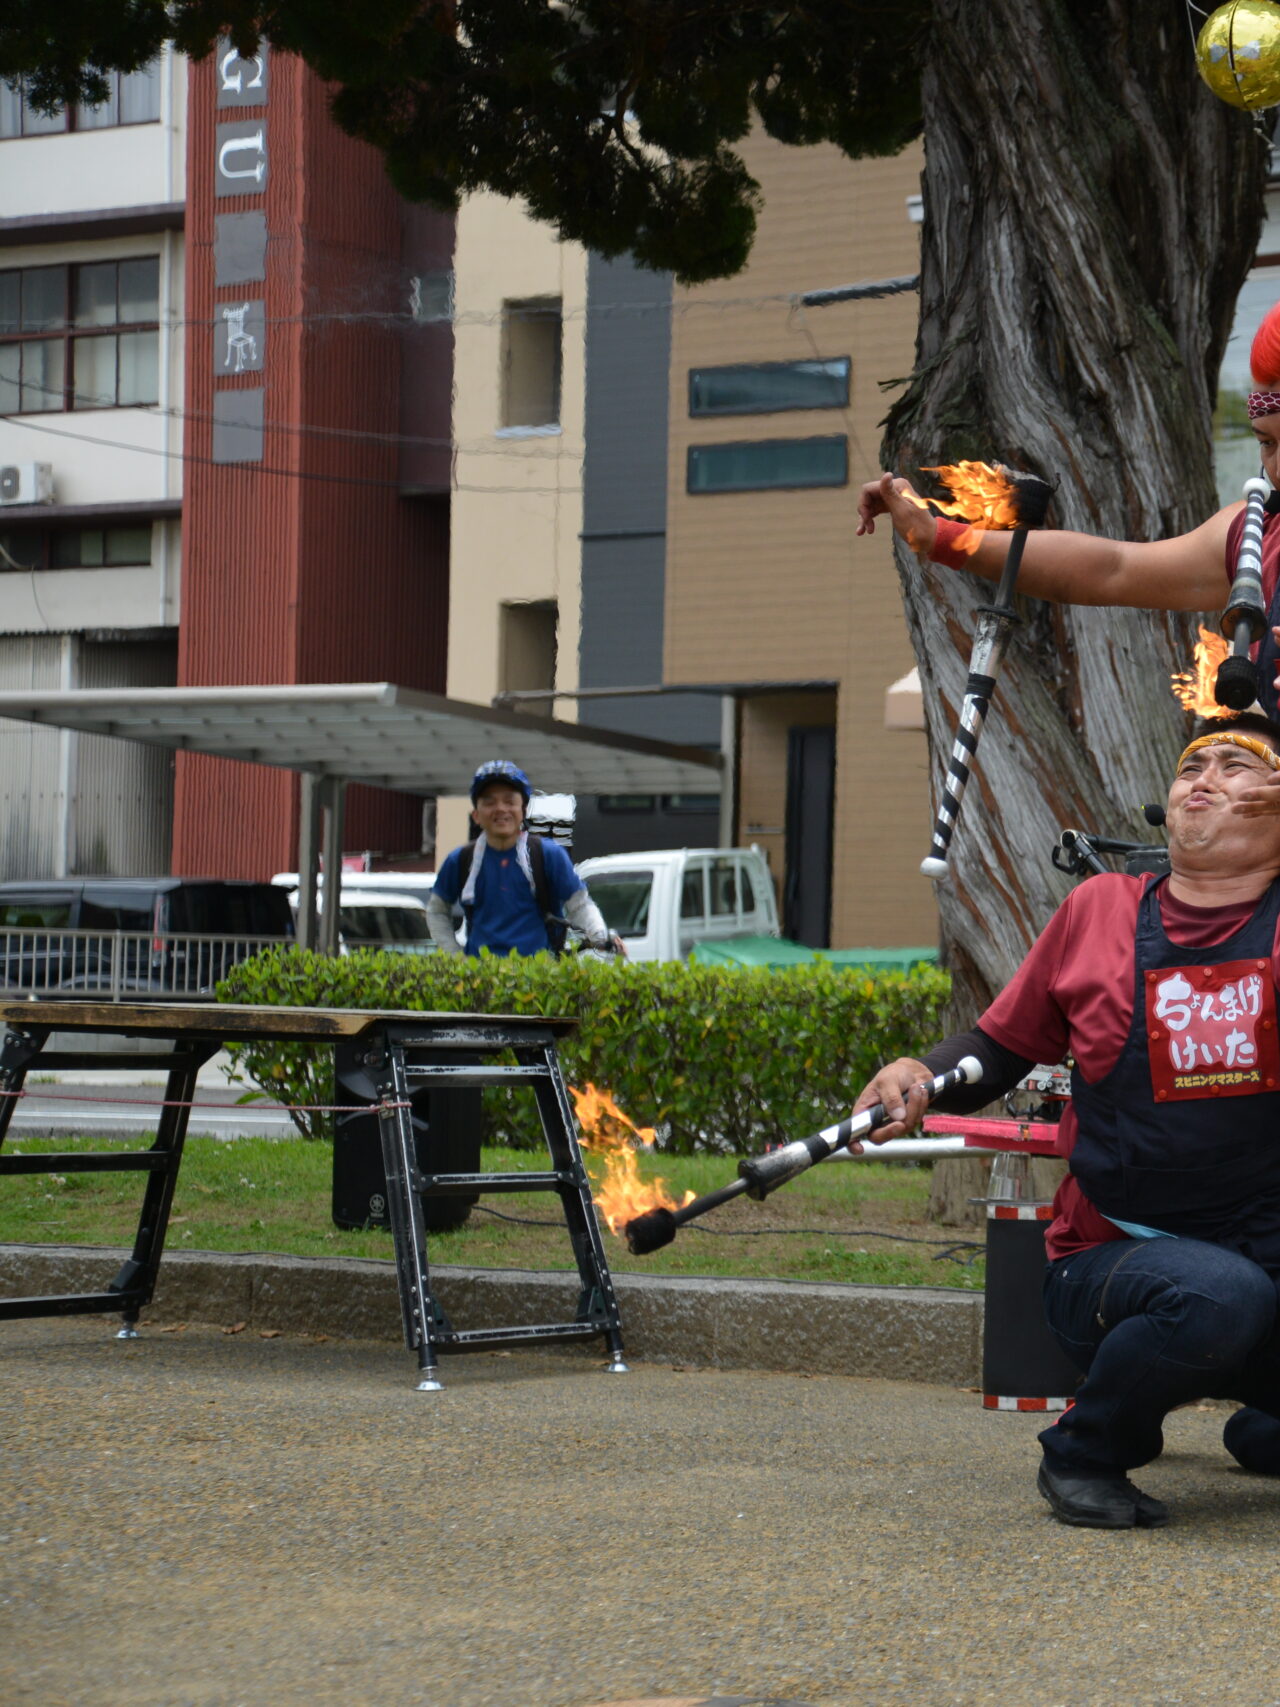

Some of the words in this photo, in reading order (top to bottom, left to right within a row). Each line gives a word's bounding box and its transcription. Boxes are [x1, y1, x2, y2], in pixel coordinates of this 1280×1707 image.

[1155, 973, 1262, 1032] ちょんまげ
[1171, 1027, 1255, 1070] けいた
